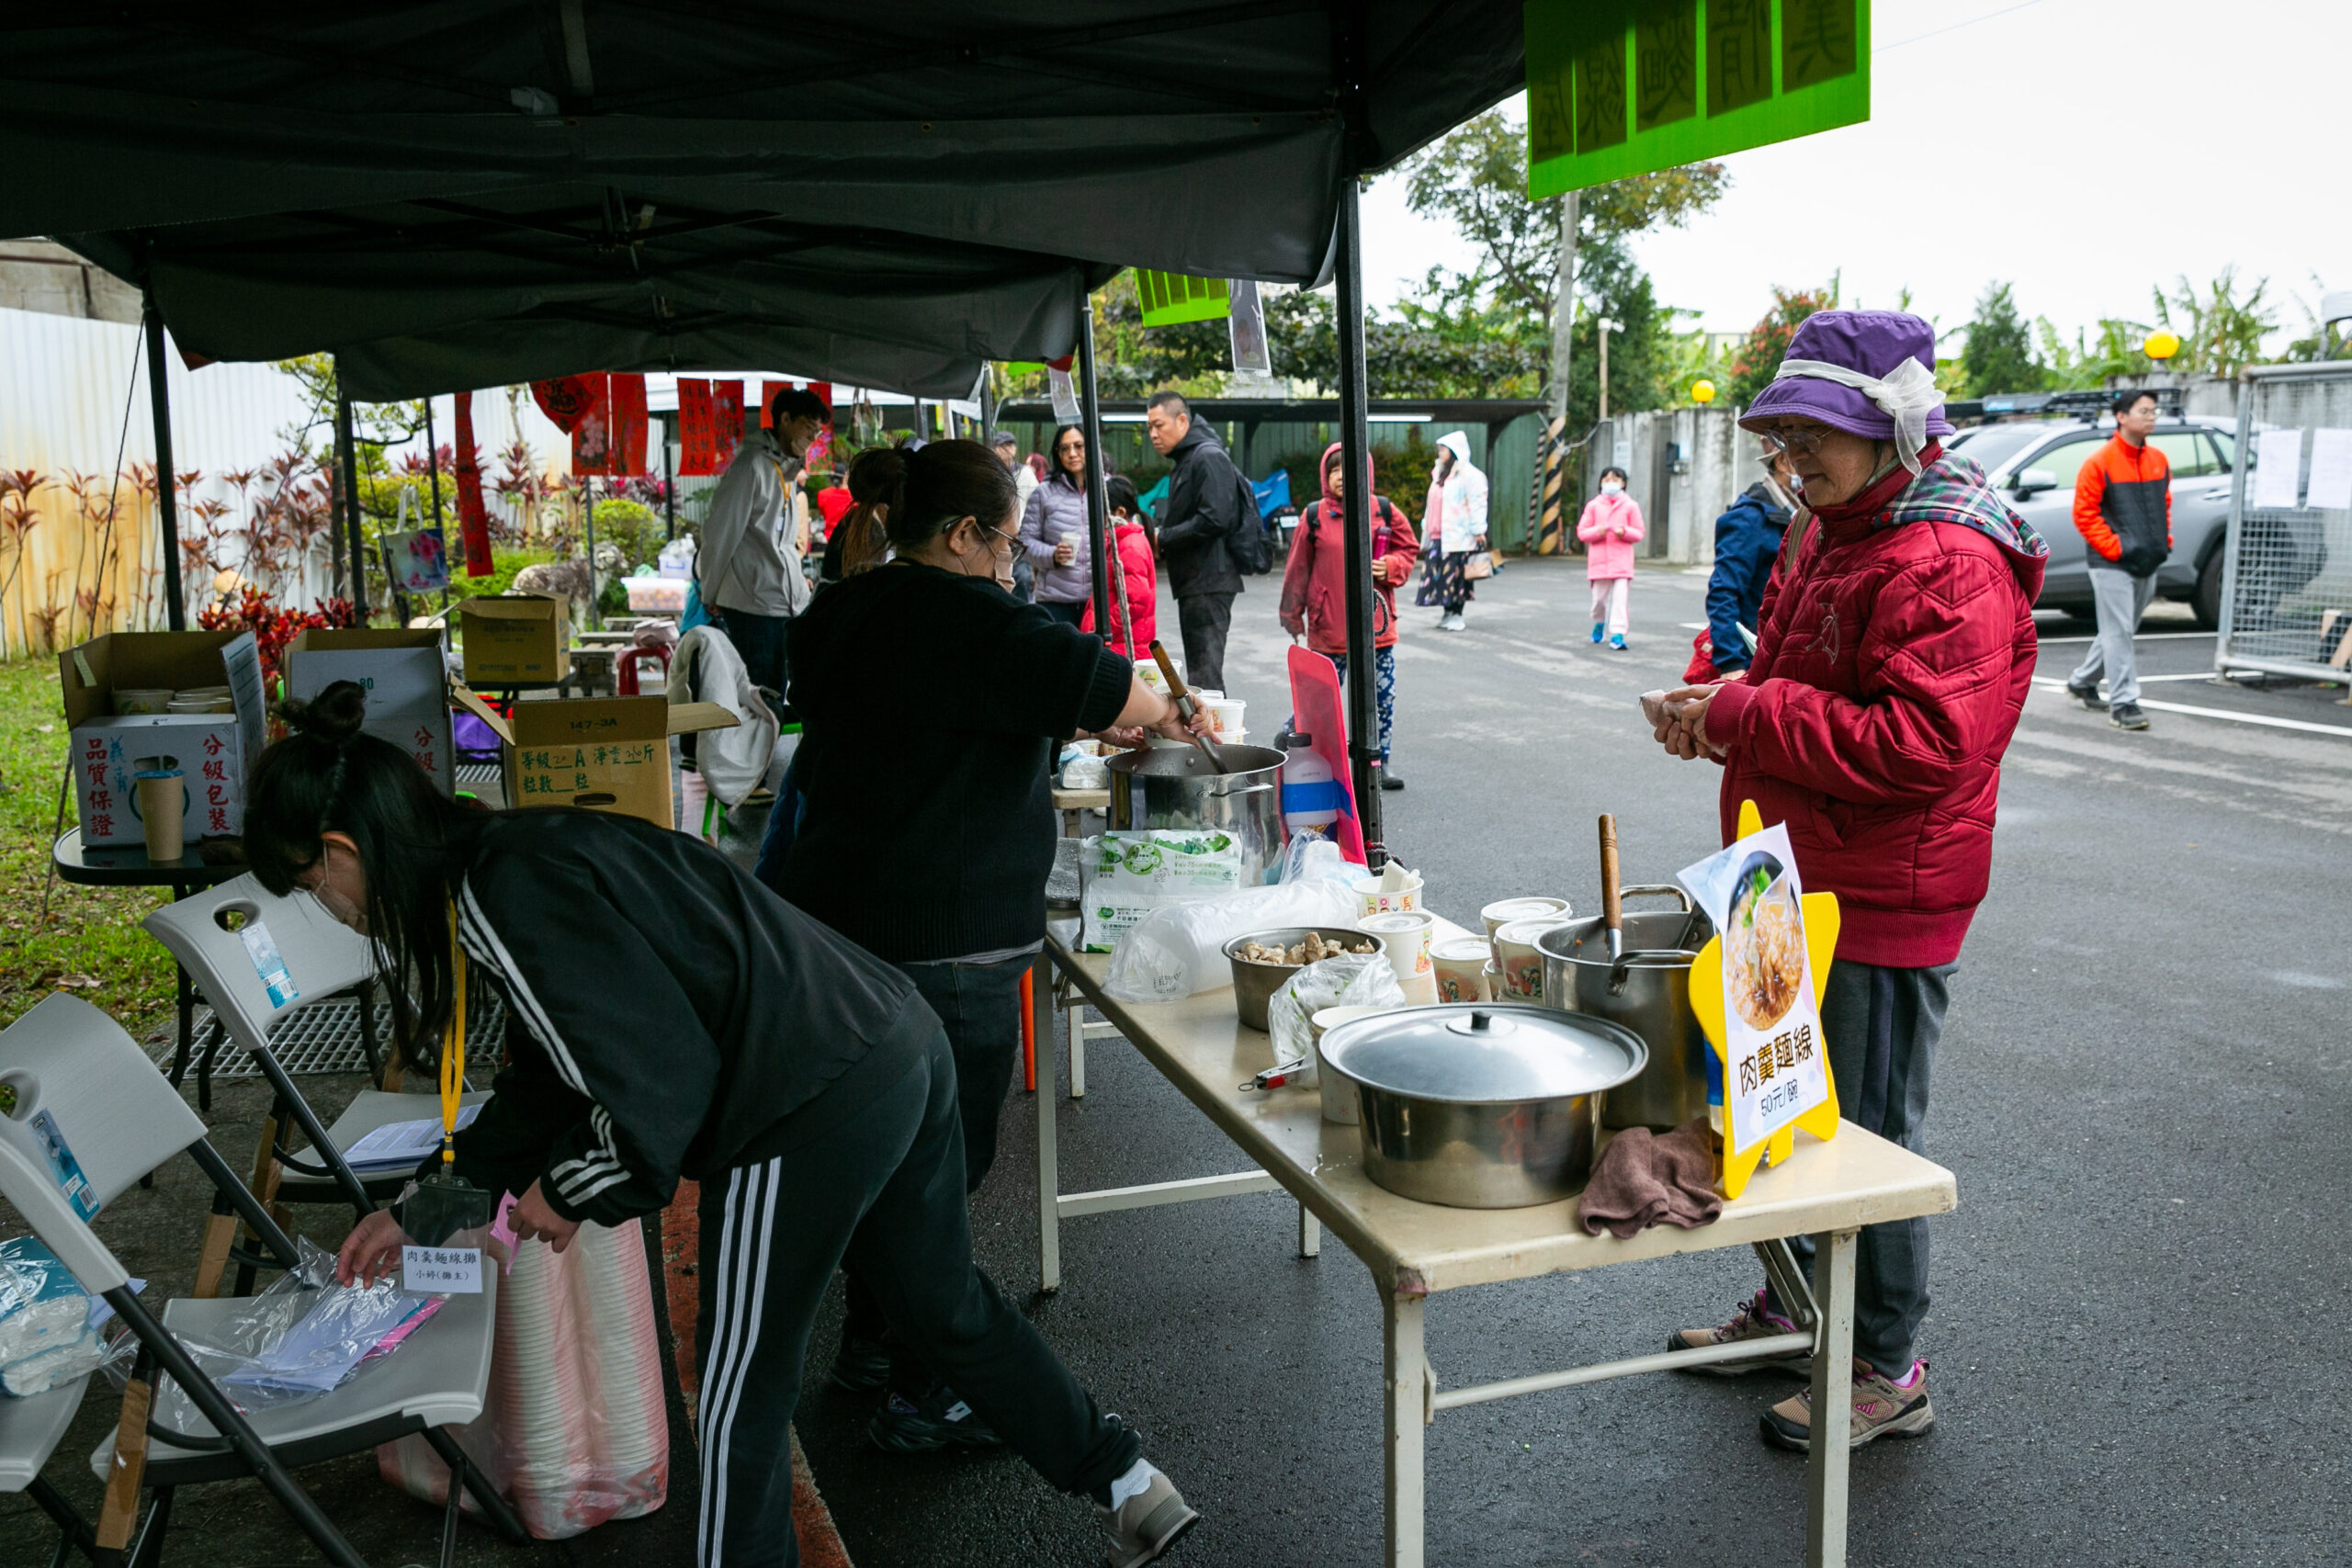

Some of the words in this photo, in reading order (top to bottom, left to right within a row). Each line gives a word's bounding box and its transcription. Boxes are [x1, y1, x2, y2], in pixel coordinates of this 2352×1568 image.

[85, 738, 116, 837] 品質保證
[202, 733, 232, 831] 分級包裝
[1739, 1022, 1814, 1097] 肉羹麵線
[1760, 1078, 1798, 1116] 50元/碗
[407, 1250, 477, 1265] 肉羹麵線攤
